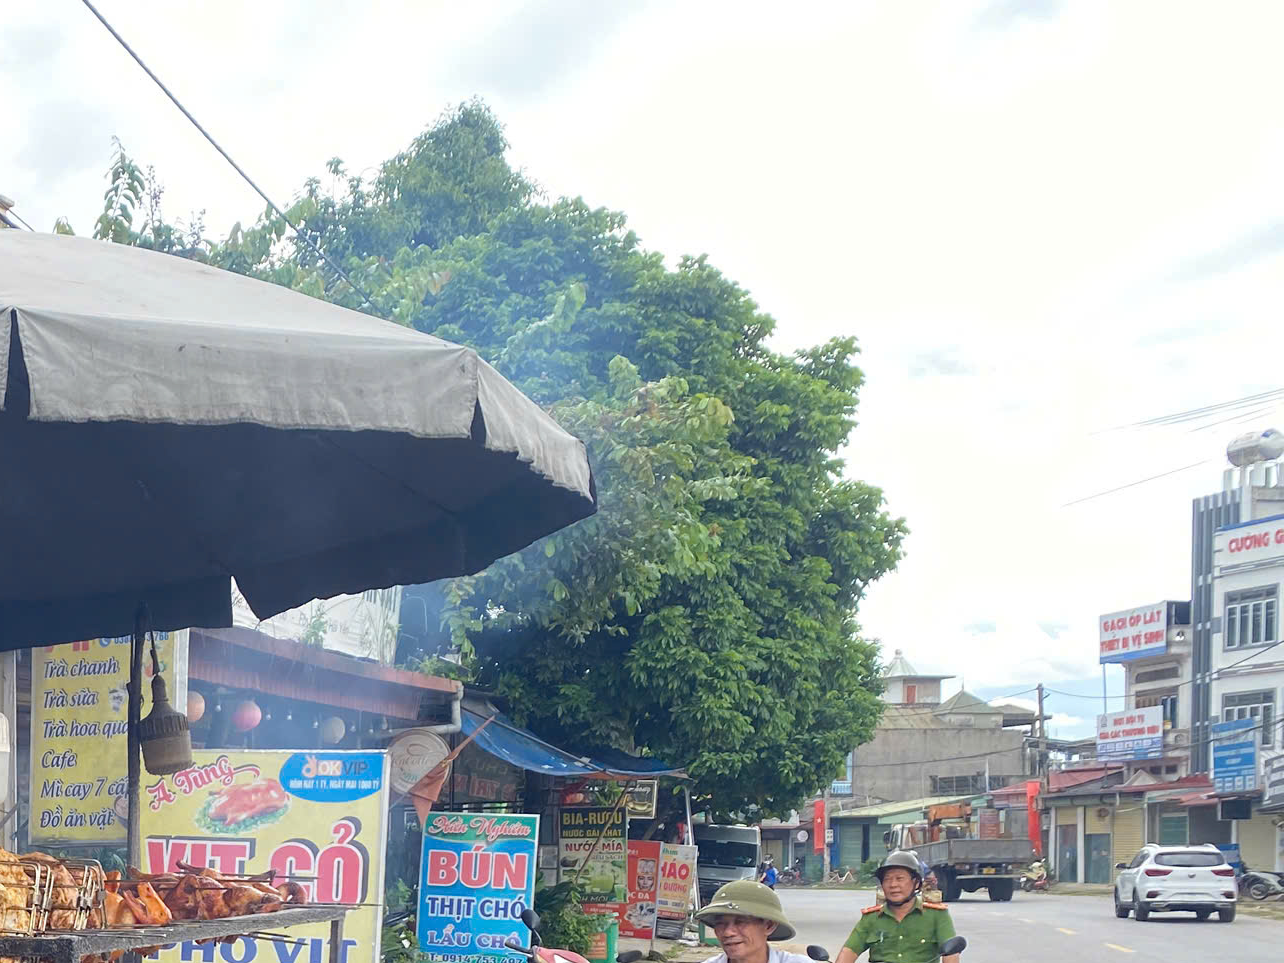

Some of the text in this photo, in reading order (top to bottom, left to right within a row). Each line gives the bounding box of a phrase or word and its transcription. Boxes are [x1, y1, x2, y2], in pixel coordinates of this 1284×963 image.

[44, 657, 120, 679] Trà chanh
[44, 689, 98, 709] Trà sữa
[43, 720, 67, 738] Trà
[70, 720, 100, 737] hoa
[42, 749, 77, 770] Cafe
[41, 779, 63, 798] Mì
[64, 783, 93, 800] cay
[95, 777, 107, 797] 7
[41, 805, 63, 828] Đồ
[602, 840, 623, 851] MÍA
[427, 844, 528, 890] BÚN
[661, 859, 690, 880] HÁO
[427, 896, 527, 920] THỊT CHÓ
